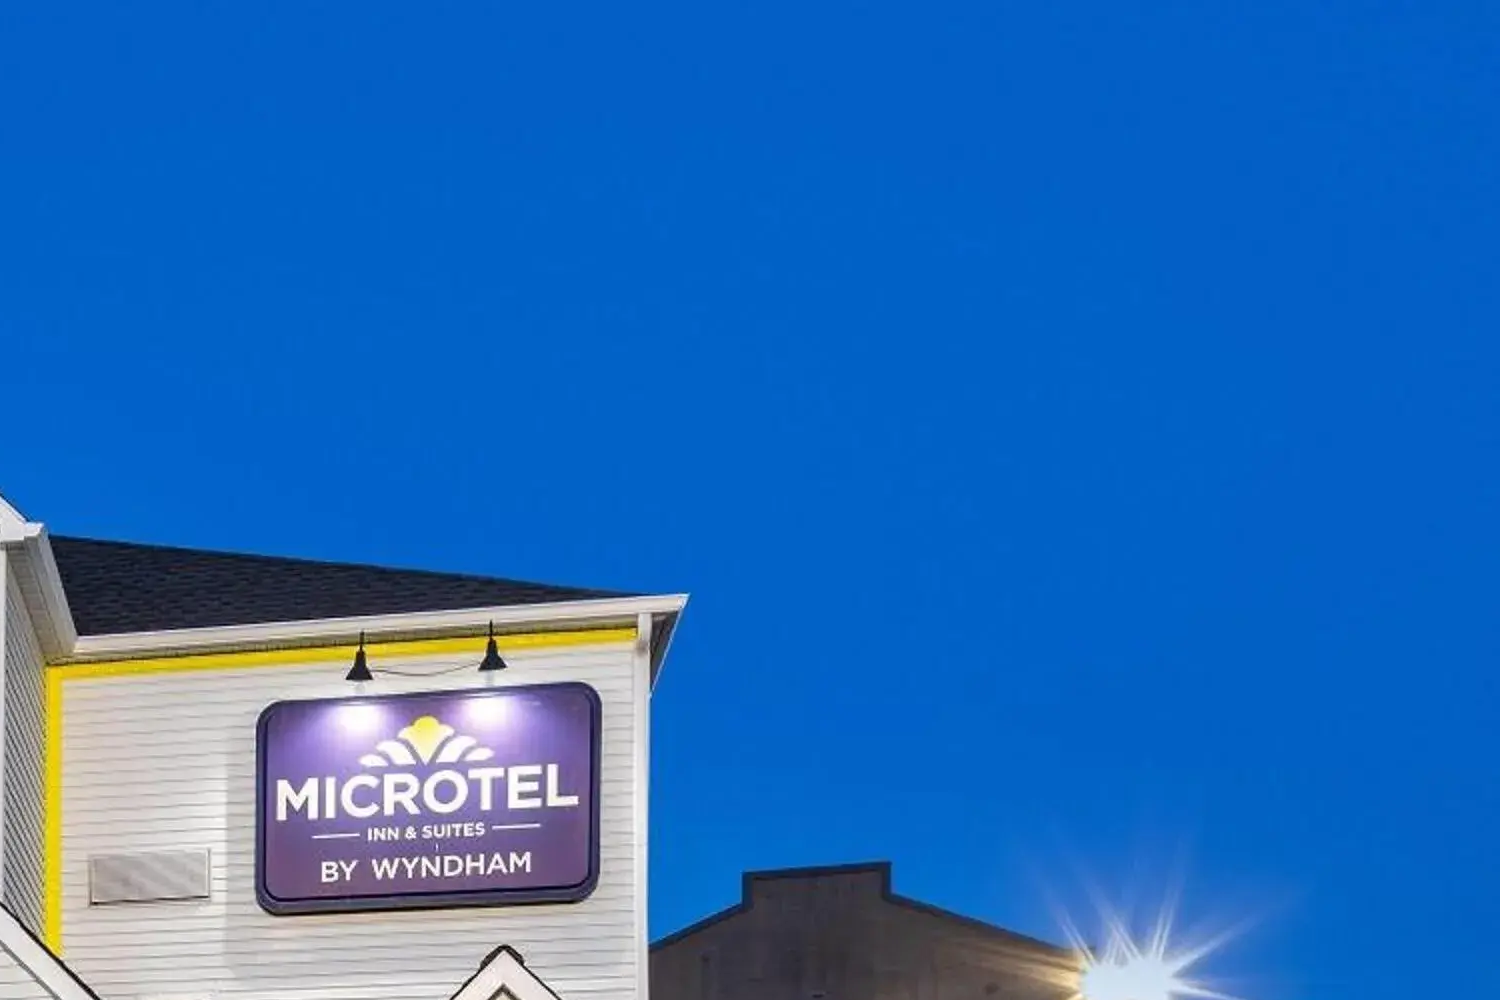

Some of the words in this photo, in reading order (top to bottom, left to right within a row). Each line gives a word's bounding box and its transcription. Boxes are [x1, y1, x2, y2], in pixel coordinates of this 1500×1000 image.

[275, 763, 580, 822] MICROTEL
[367, 826, 400, 843] INN
[404, 825, 418, 841] &
[421, 822, 486, 840] SUITES
[320, 859, 359, 884] BY
[371, 851, 533, 881] WYNDHAM
